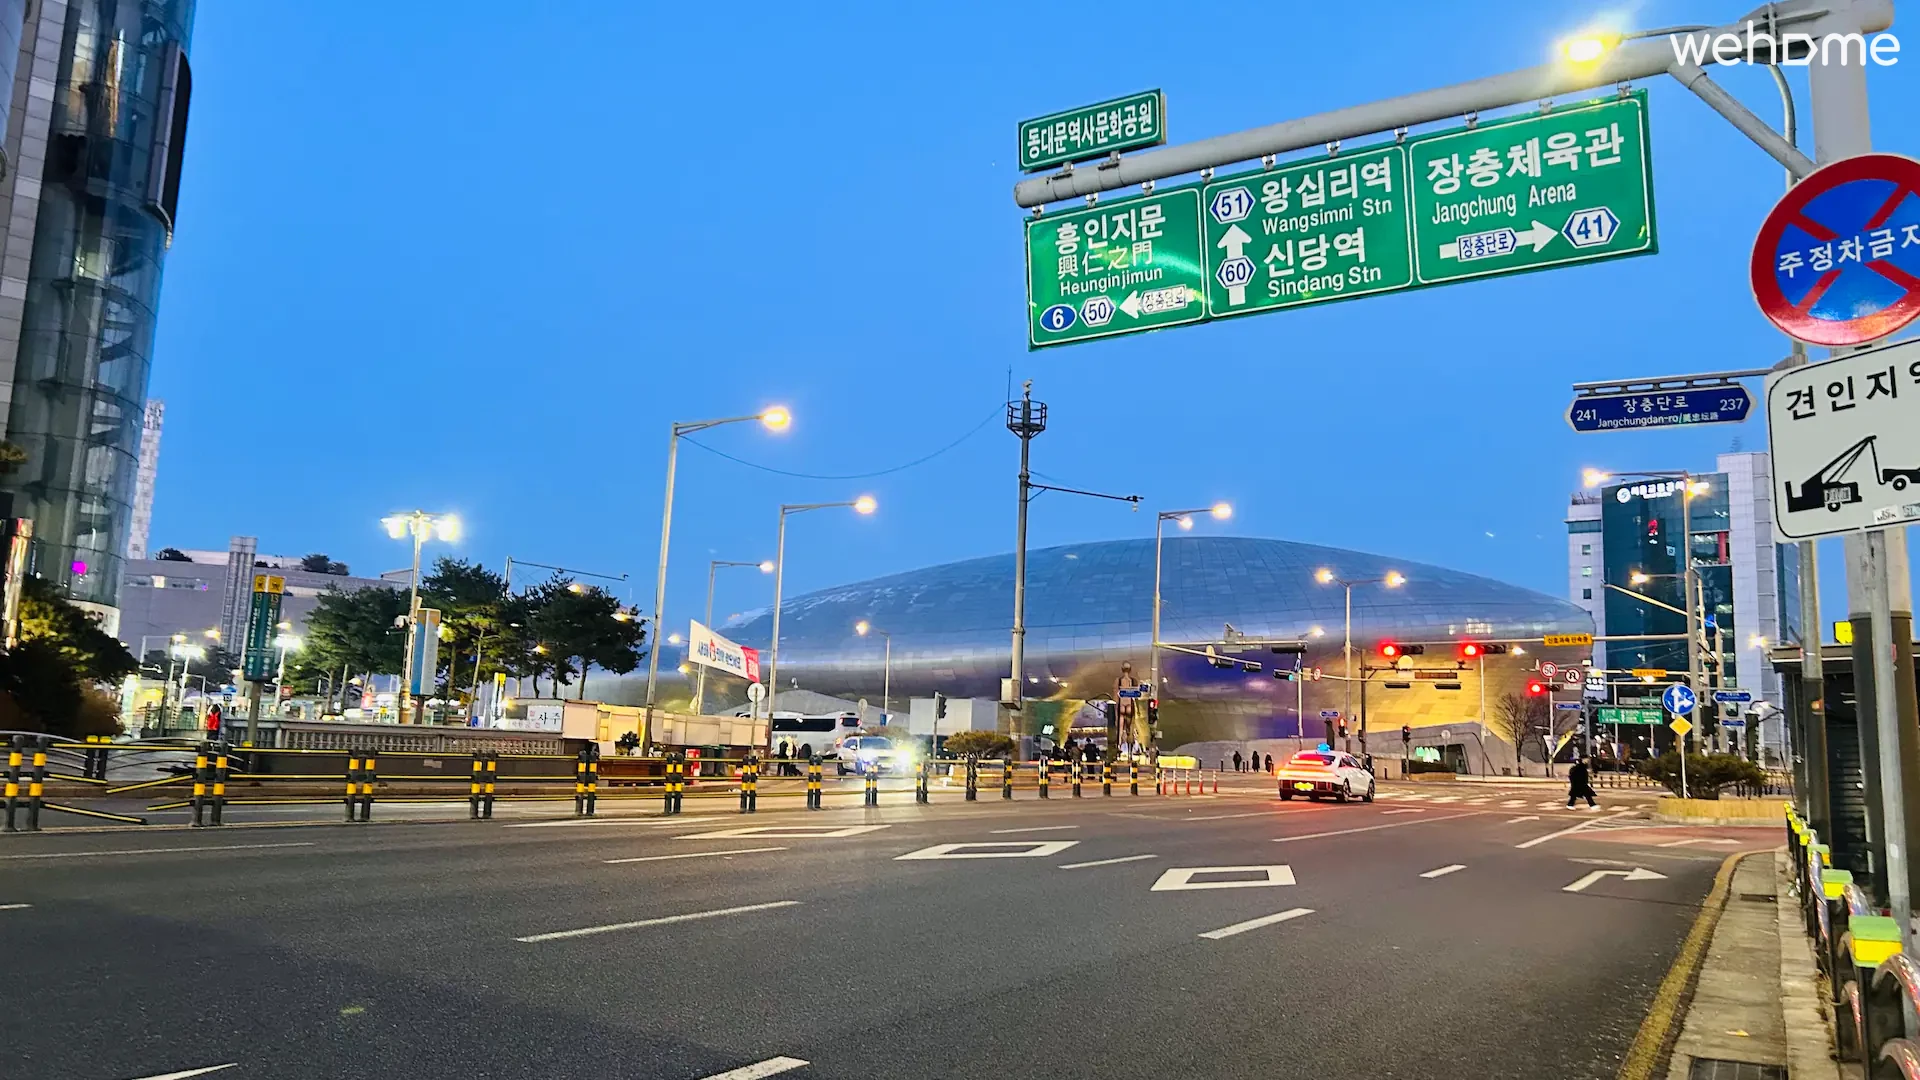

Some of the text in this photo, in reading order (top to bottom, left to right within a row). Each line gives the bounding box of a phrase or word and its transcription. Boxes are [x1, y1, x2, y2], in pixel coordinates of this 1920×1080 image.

[1027, 100, 1152, 159] 동대문역사문화공원
[1426, 122, 1625, 195] 장충체육관
[1260, 156, 1392, 214] 왕십리역
[1221, 193, 1244, 216] 51
[1262, 198, 1392, 235] Wangsimni Stn
[1432, 183, 1576, 225] Jangchung Arena
[1055, 203, 1166, 255] 흥인지문
[1576, 214, 1604, 240] 41
[1057, 240, 1153, 280] 興仁之門
[1264, 226, 1366, 278] 신당역
[1462, 233, 1508, 257] 장충단로
[1060, 266, 1163, 296] Heunginjimun
[1225, 263, 1246, 282] 60
[1268, 266, 1382, 298] Sindang Stn
[1052, 310, 1064, 326] 6
[1088, 302, 1107, 321] 50
[1576, 409, 1597, 422] 241
[1623, 396, 1688, 413] 장충단로
[1719, 398, 1743, 411] 237
